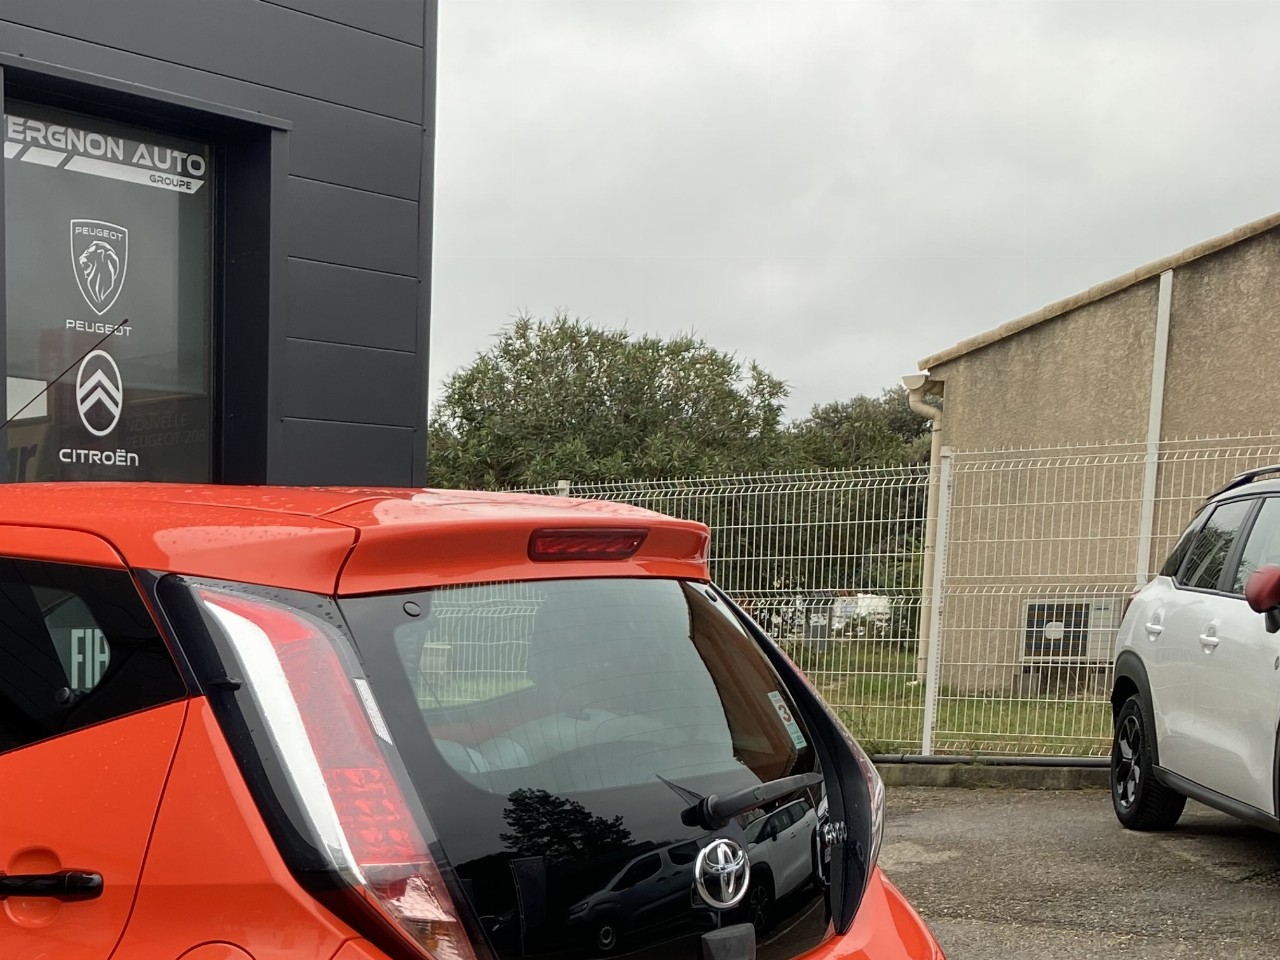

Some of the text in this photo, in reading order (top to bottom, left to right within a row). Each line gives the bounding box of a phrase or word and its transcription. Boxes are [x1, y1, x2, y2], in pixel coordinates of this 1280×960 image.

[4, 115, 206, 176] ERGNON AUTO
[149, 174, 192, 190] GROUPE
[75, 226, 123, 241] PEUGEOT
[66, 319, 133, 337] PEUGEOT
[71, 628, 111, 689] FIA
